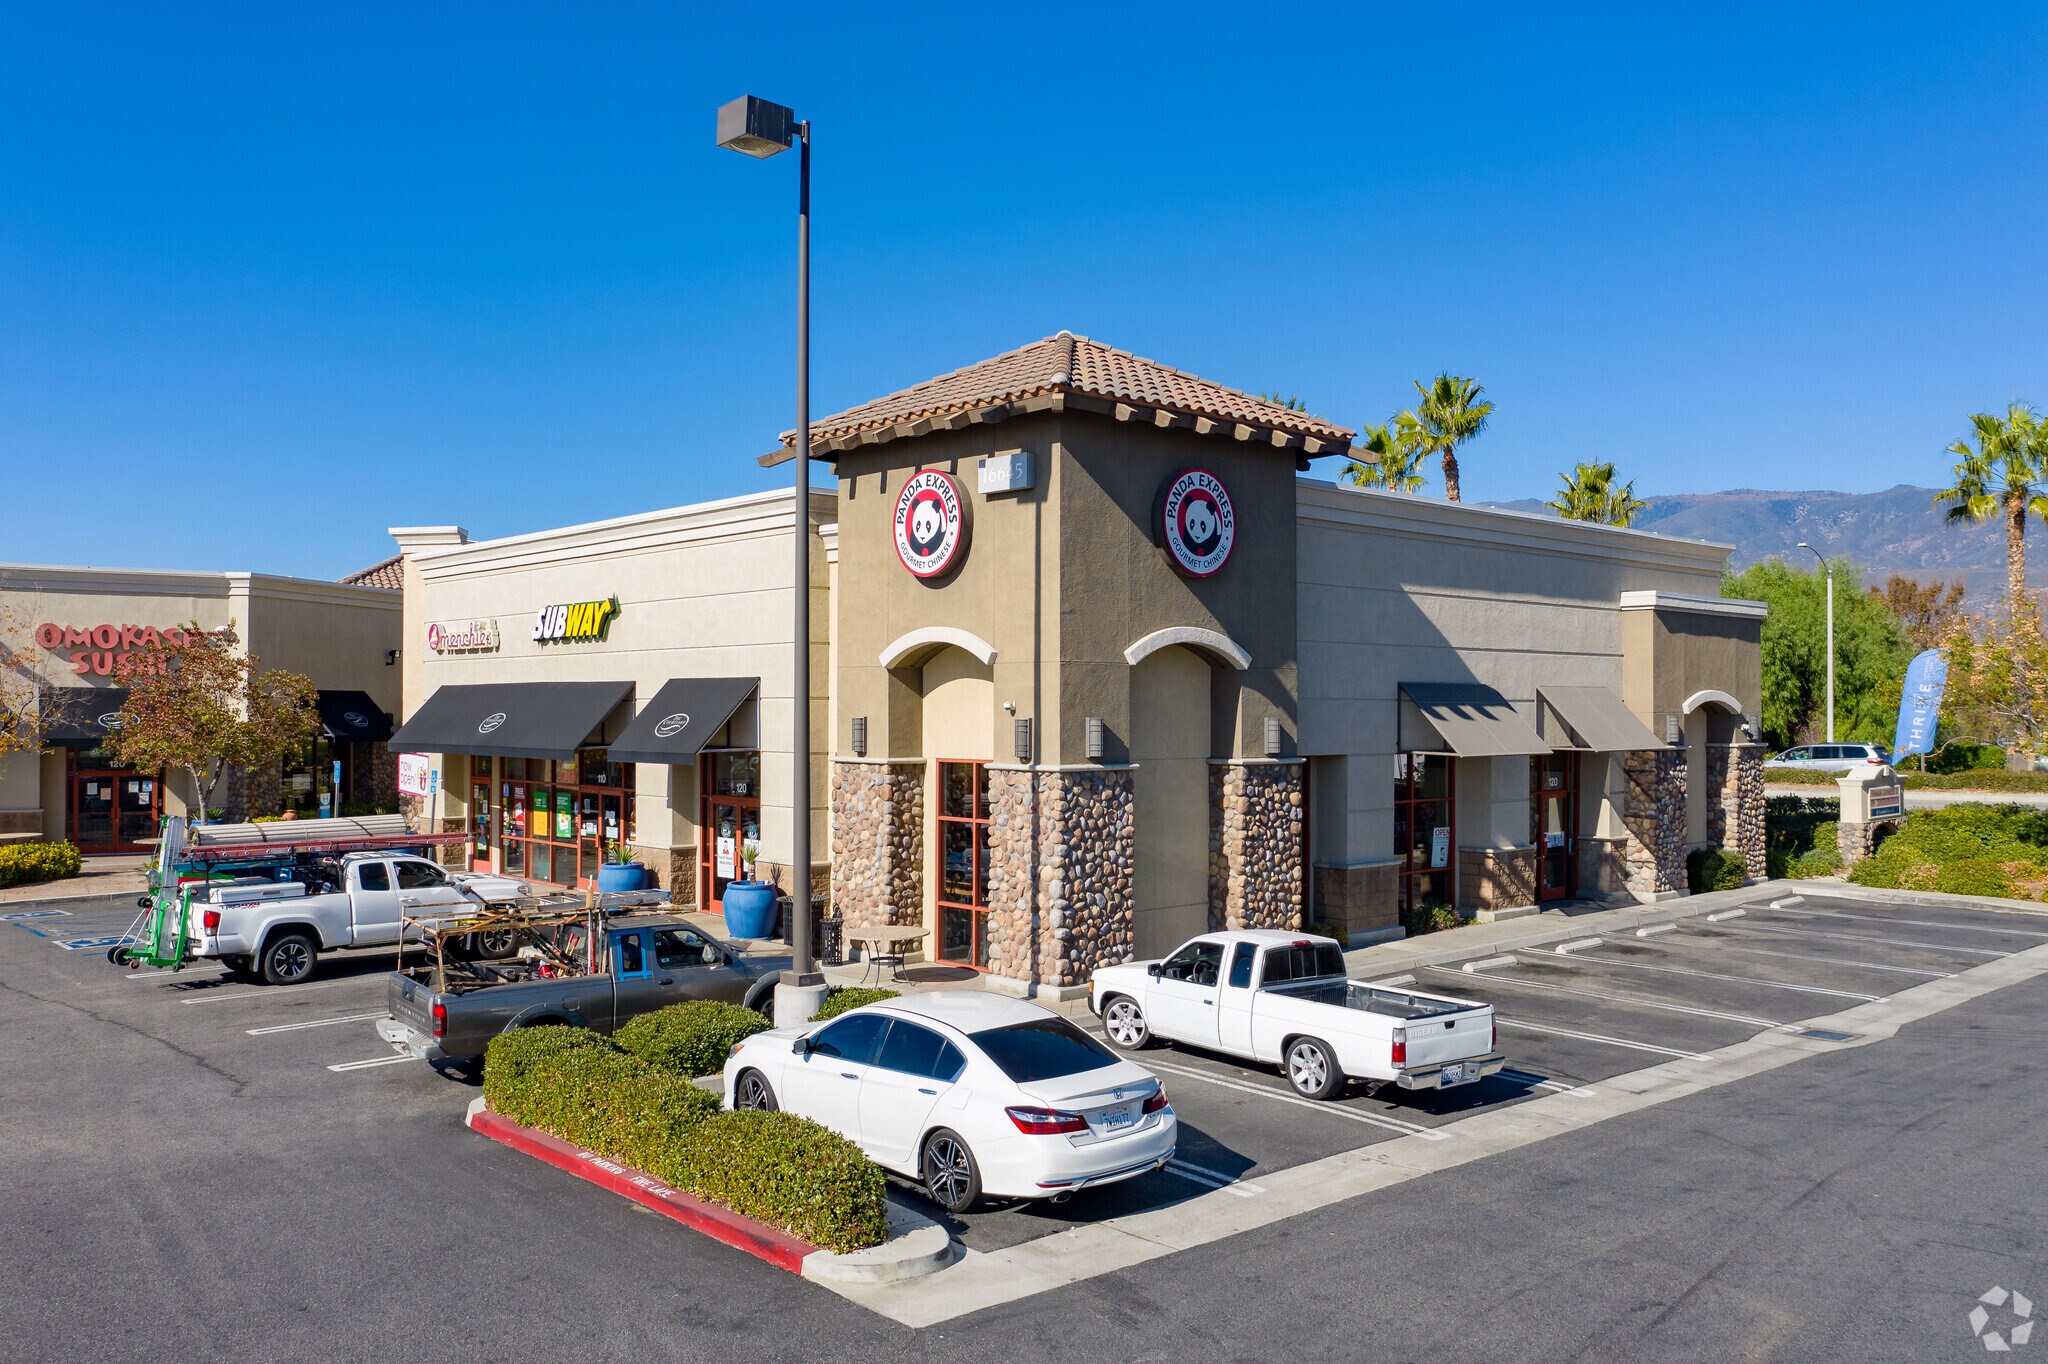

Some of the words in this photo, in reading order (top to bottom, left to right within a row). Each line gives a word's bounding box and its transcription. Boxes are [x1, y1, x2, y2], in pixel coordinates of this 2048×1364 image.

[983, 462, 1023, 484] 16645
[897, 478, 922, 524] PANDA
[925, 474, 957, 524] EXPRESS
[1167, 474, 1195, 519] PANDA
[1199, 473, 1233, 528] EXPRESS
[900, 541, 926, 569] GOURMET
[927, 541, 951, 568] CHINESE
[1172, 537, 1202, 568] GOURMET
[1203, 543, 1227, 568] CHINESE
[531, 599, 611, 639] SUBWAY
[1908, 683, 1932, 750] THRIVE
[400, 761, 413, 772] now
[597, 774, 607, 784] 110
[736, 783, 748, 793] 120
[1434, 829, 1450, 837] OPEN
[1409, 1026, 1439, 1039] NISSAN
[575, 1151, 594, 1159] NO
[588, 1156, 627, 1175] PARKING
[629, 1175, 655, 1188] FIRE
[647, 1184, 677, 1198] LANE
